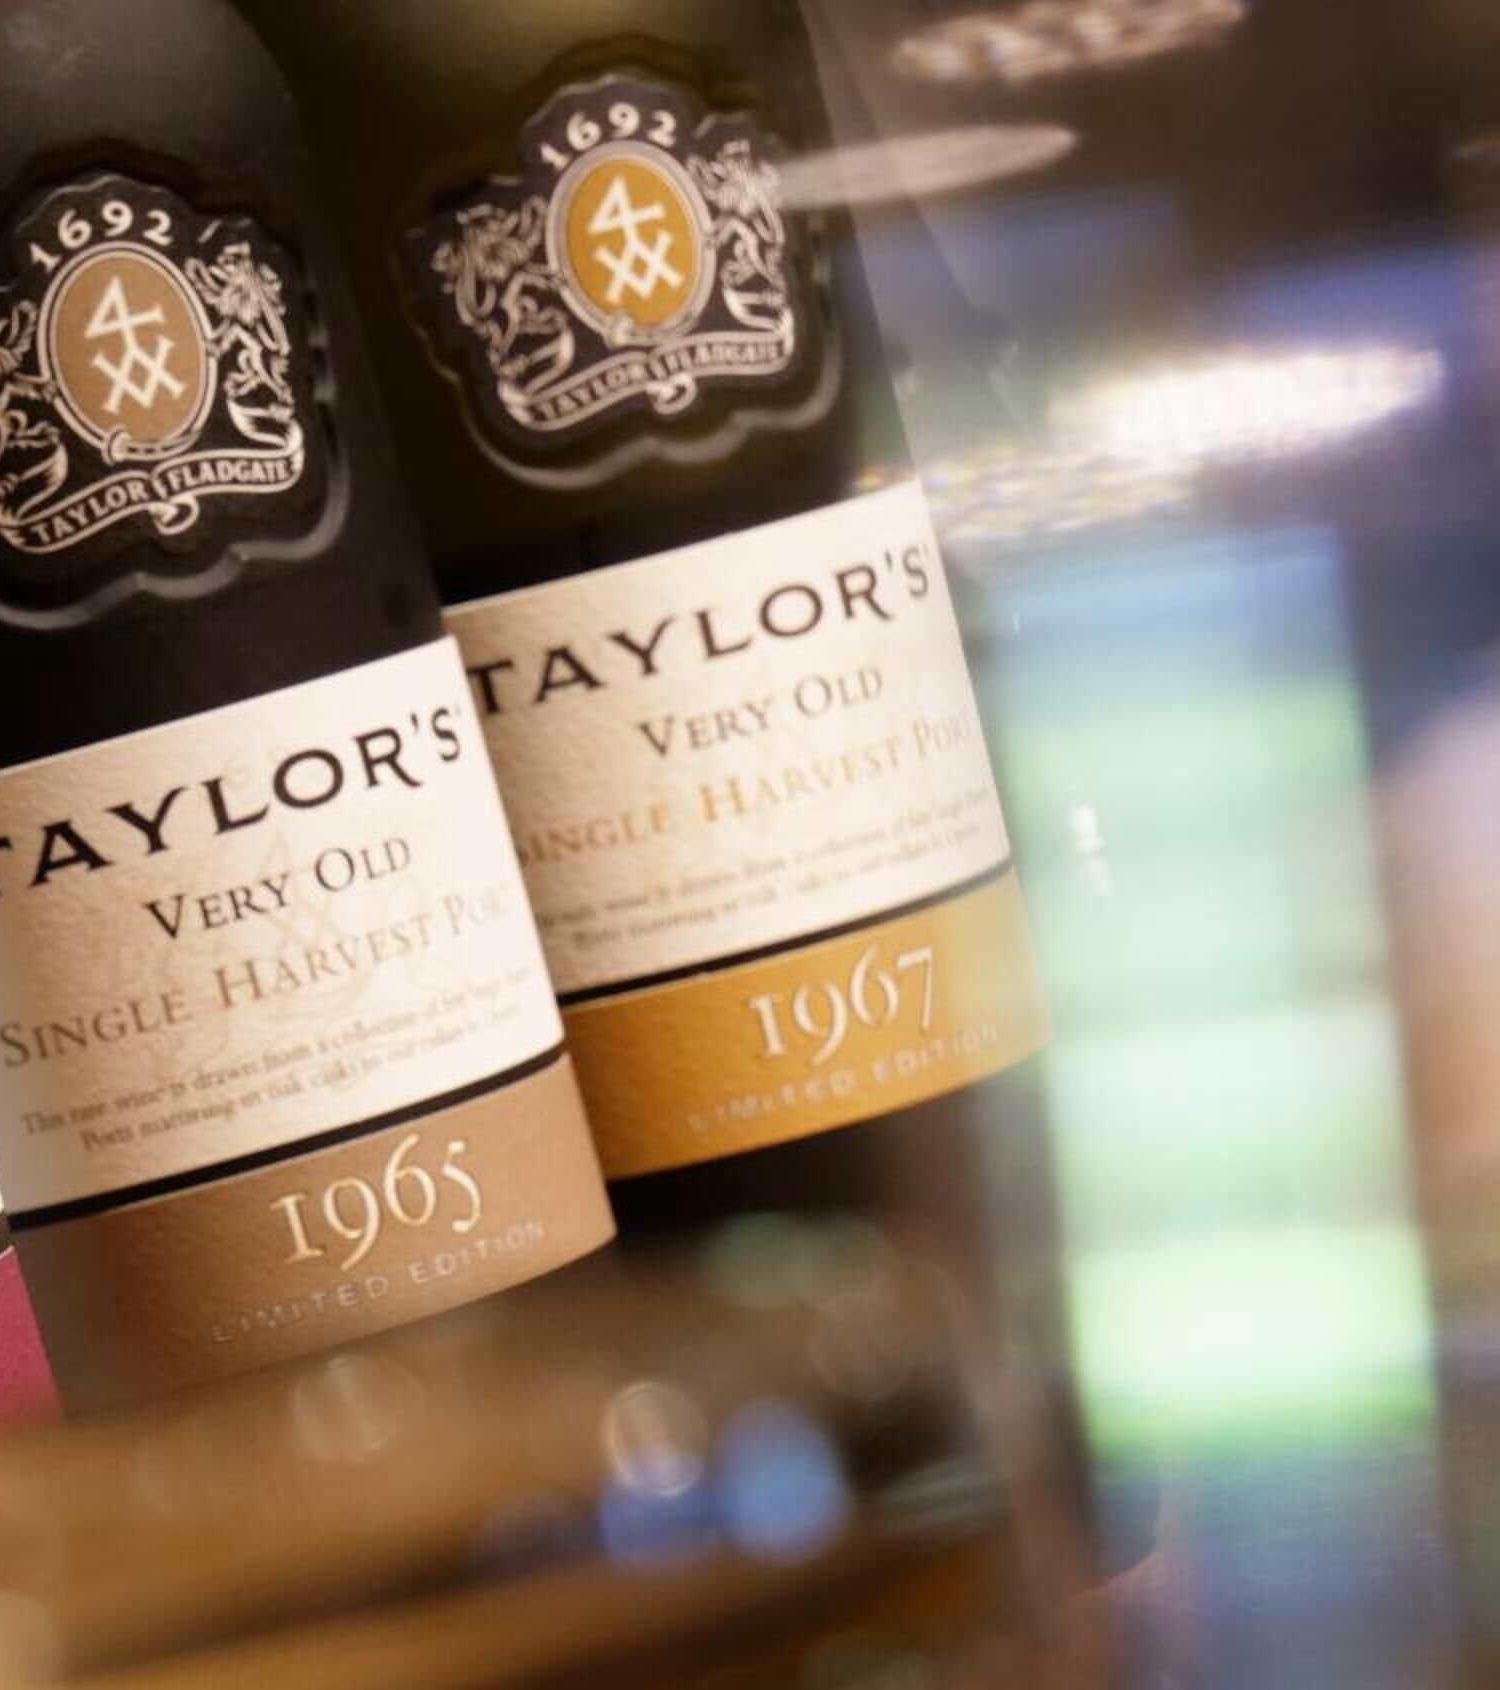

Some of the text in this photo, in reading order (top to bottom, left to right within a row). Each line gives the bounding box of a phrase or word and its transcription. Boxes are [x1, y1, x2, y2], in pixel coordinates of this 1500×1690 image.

[539, 103, 677, 169] 1692
[28, 200, 173, 272] 1692
[33, 459, 291, 545] TAYLOR FLADGATE
[750, 943, 933, 1066] 1967
[270, 1132, 482, 1270] 1965
[212, 1217, 546, 1343] LIMITED EDITION
